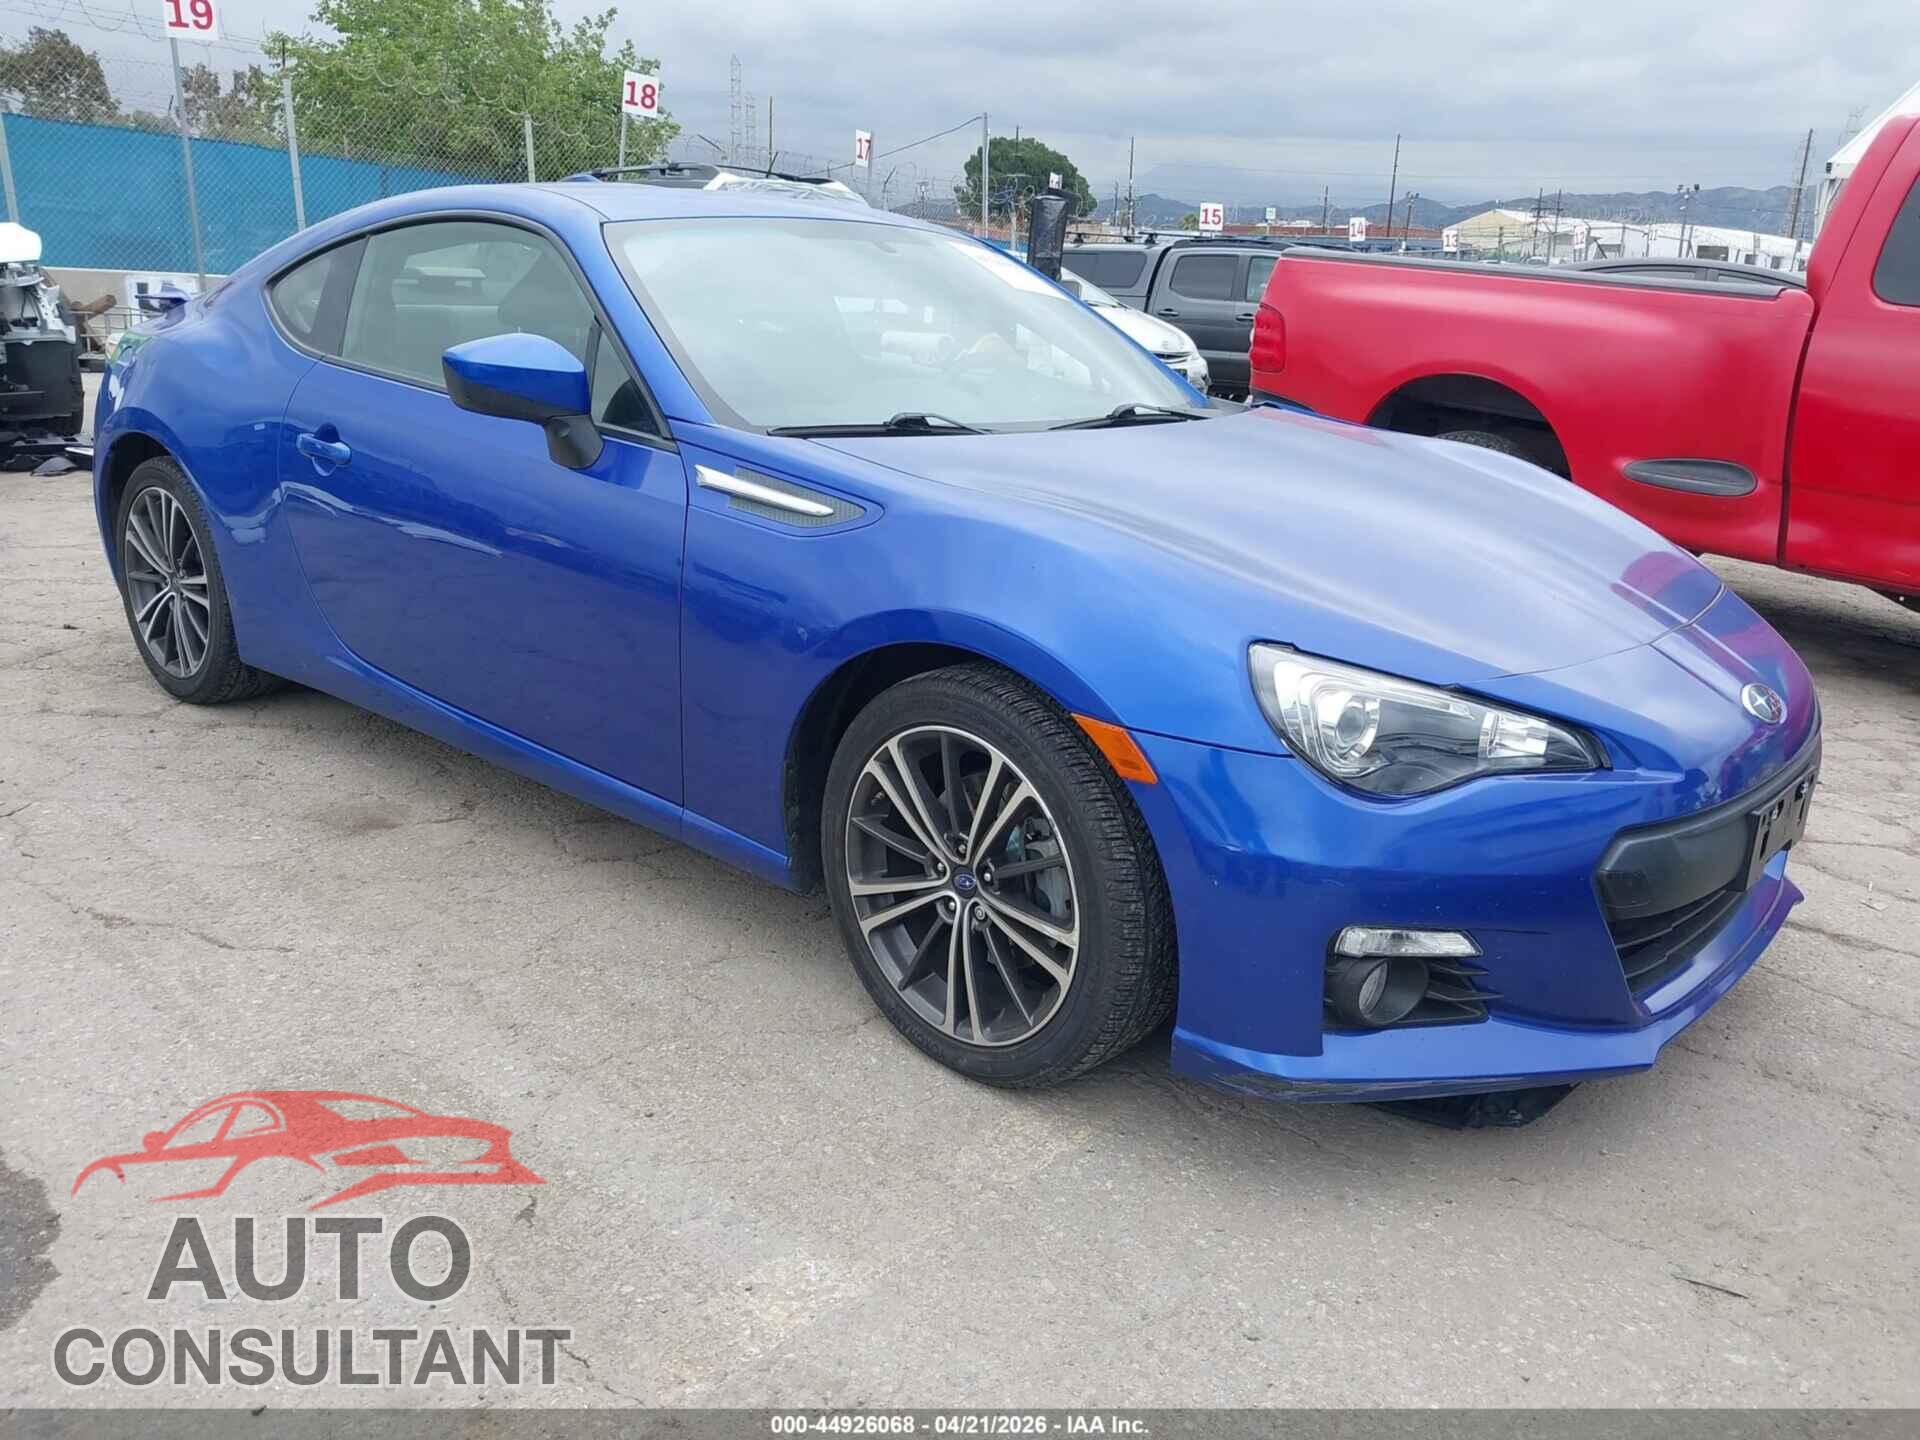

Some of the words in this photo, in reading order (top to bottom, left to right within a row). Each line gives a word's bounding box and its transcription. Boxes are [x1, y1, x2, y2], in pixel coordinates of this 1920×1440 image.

[165, 0, 213, 30] 19
[625, 81, 656, 109] 18
[857, 137, 871, 160] 17
[1201, 208, 1221, 225] 15
[1351, 222, 1364, 237] 14
